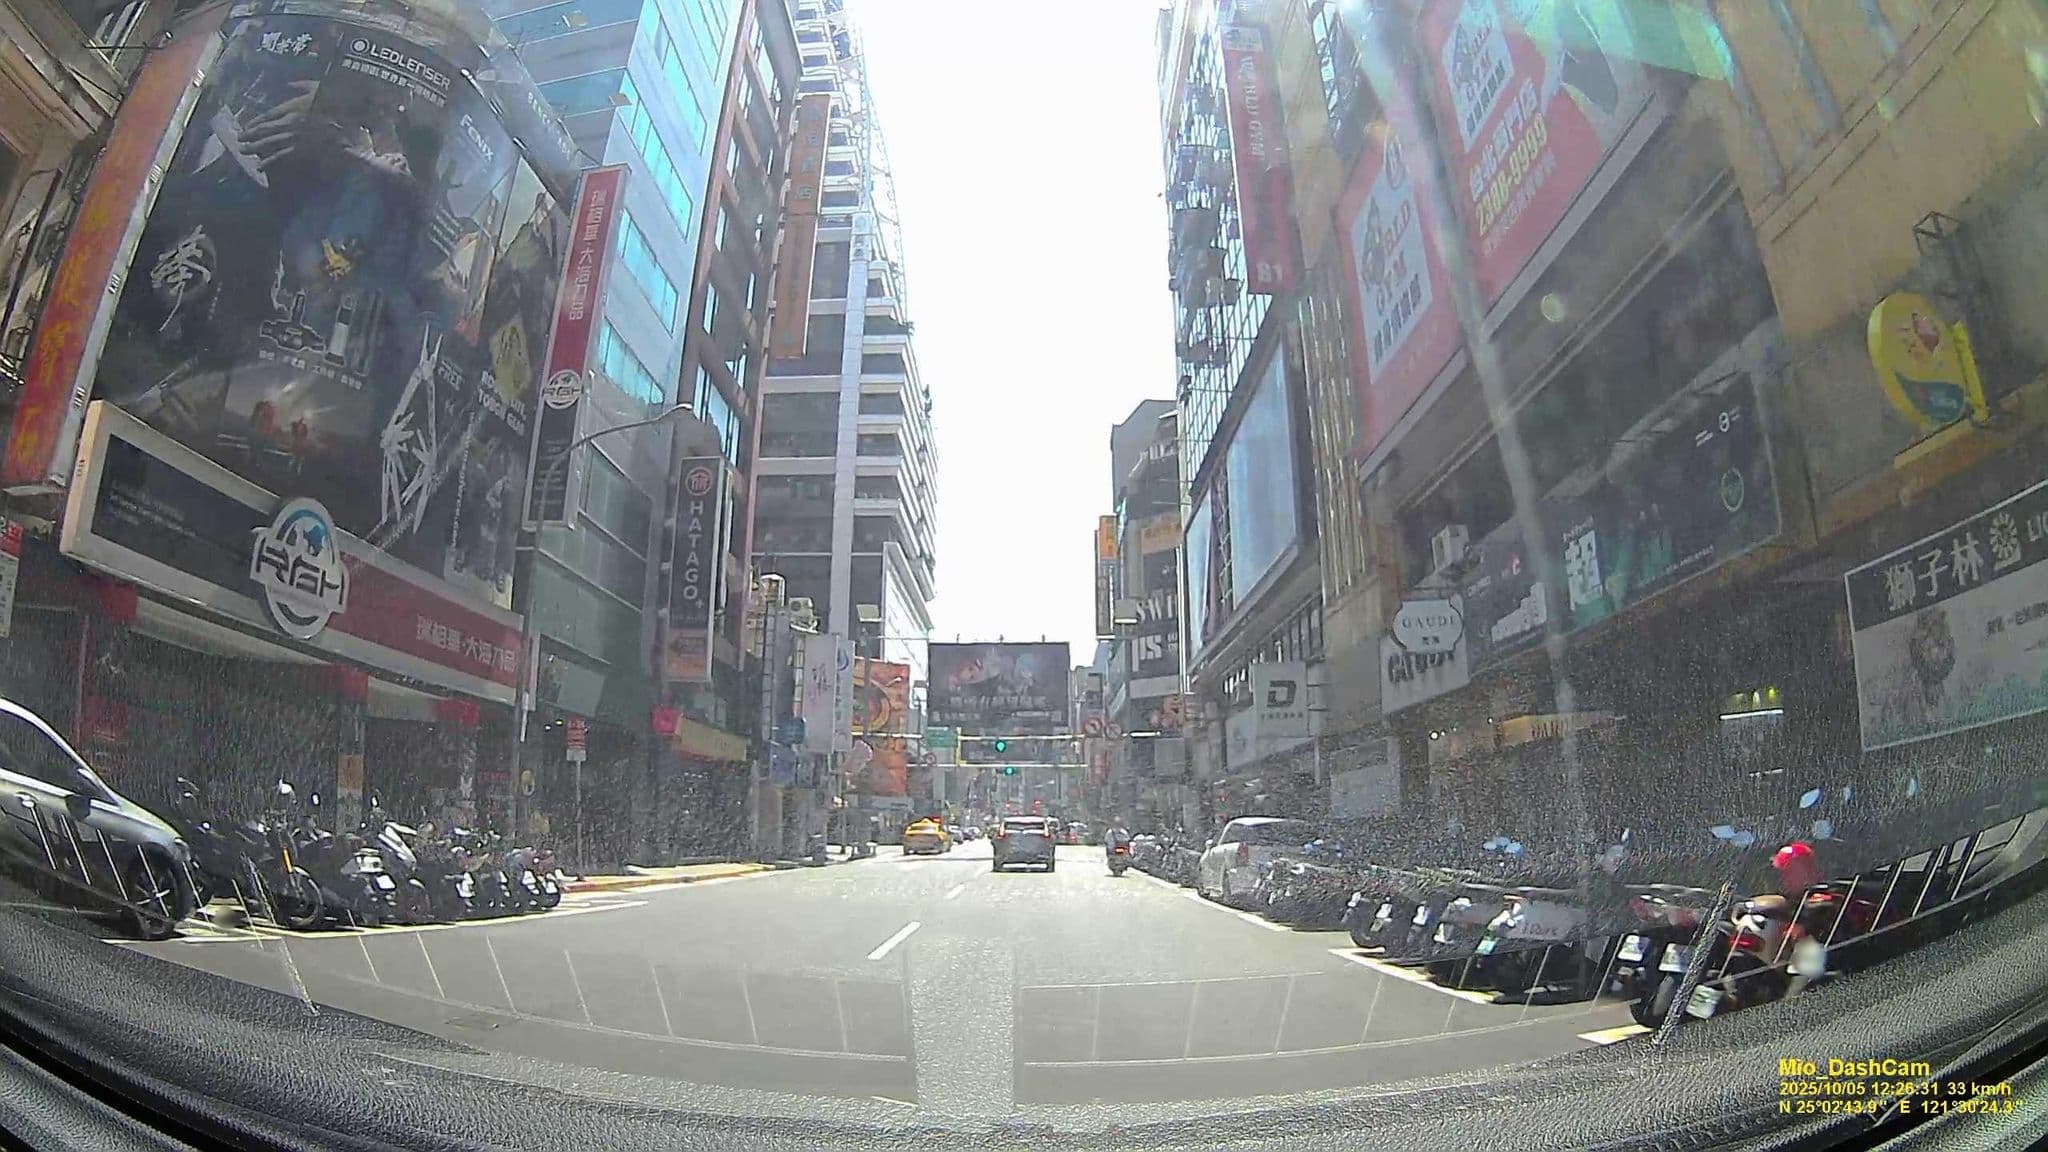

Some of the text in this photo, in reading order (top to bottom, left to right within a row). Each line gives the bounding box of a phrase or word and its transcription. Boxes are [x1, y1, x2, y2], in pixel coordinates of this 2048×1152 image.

[370, 44, 451, 91] LEDLENSER
[683, 501, 704, 600] HATAGO
[1881, 531, 1985, 613] 獅子林
